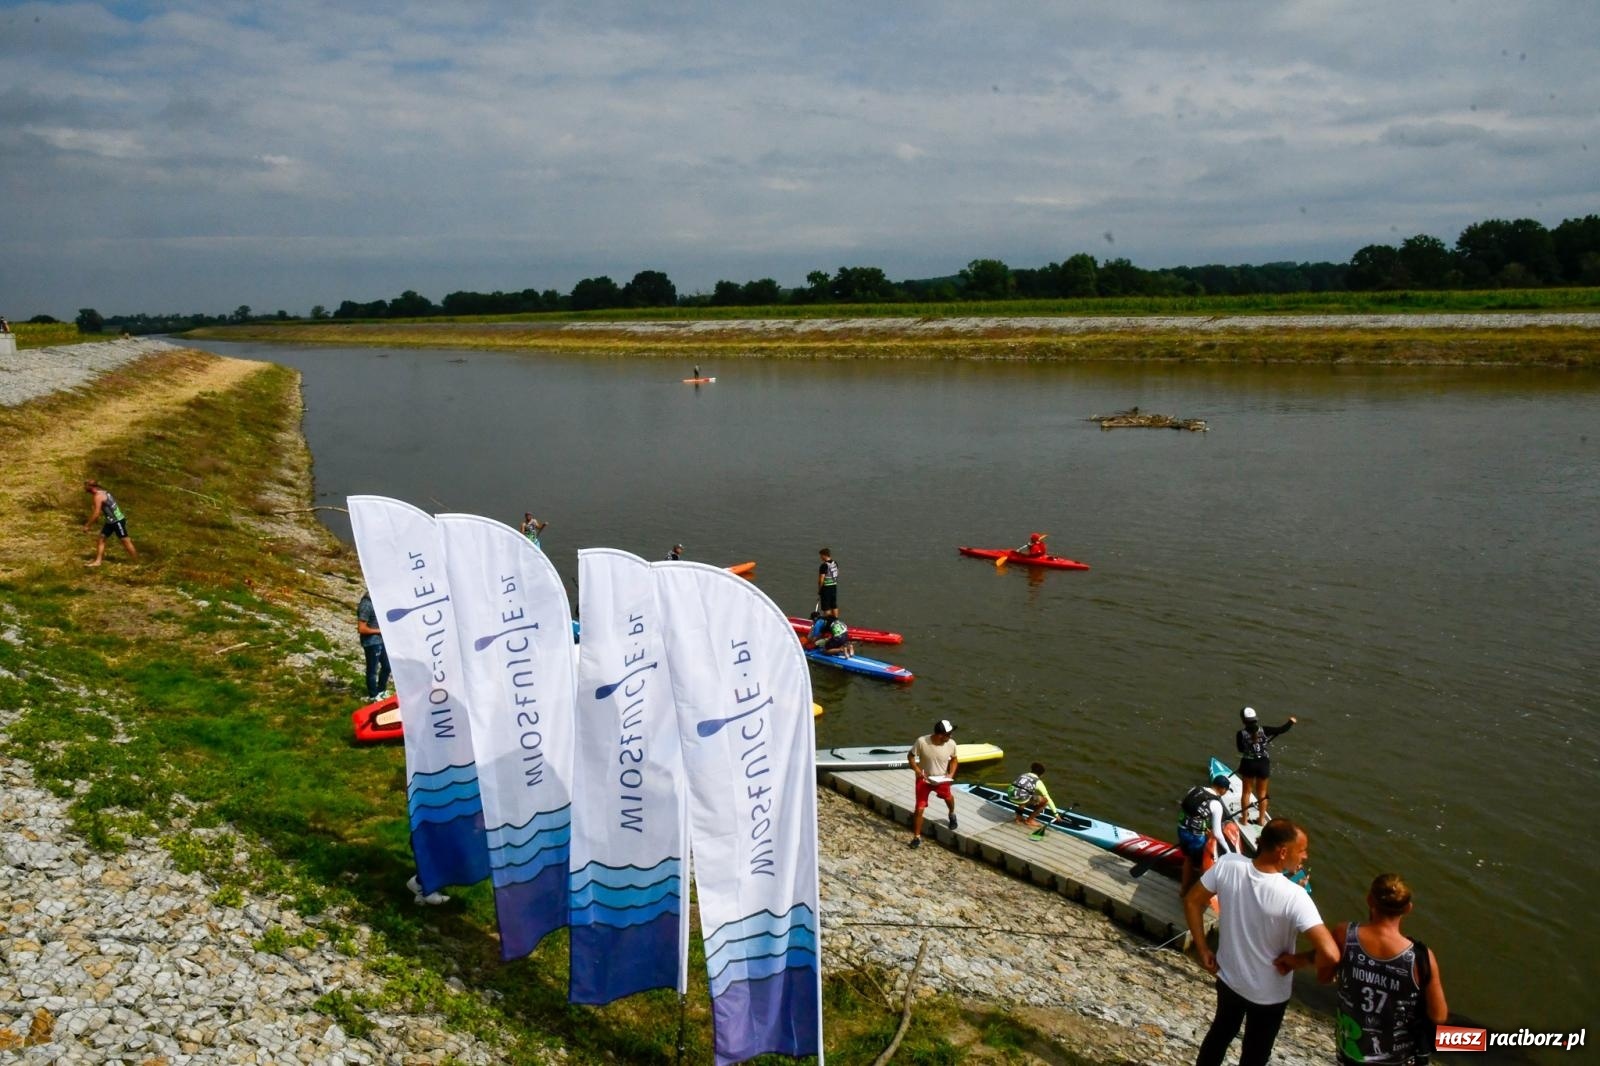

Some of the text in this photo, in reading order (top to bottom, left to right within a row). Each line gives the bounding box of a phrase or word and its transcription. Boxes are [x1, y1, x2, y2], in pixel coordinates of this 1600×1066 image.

[1352, 967, 1388, 988] NOWAK
[1390, 978, 1400, 991] M
[1360, 986, 1388, 1014] 37
